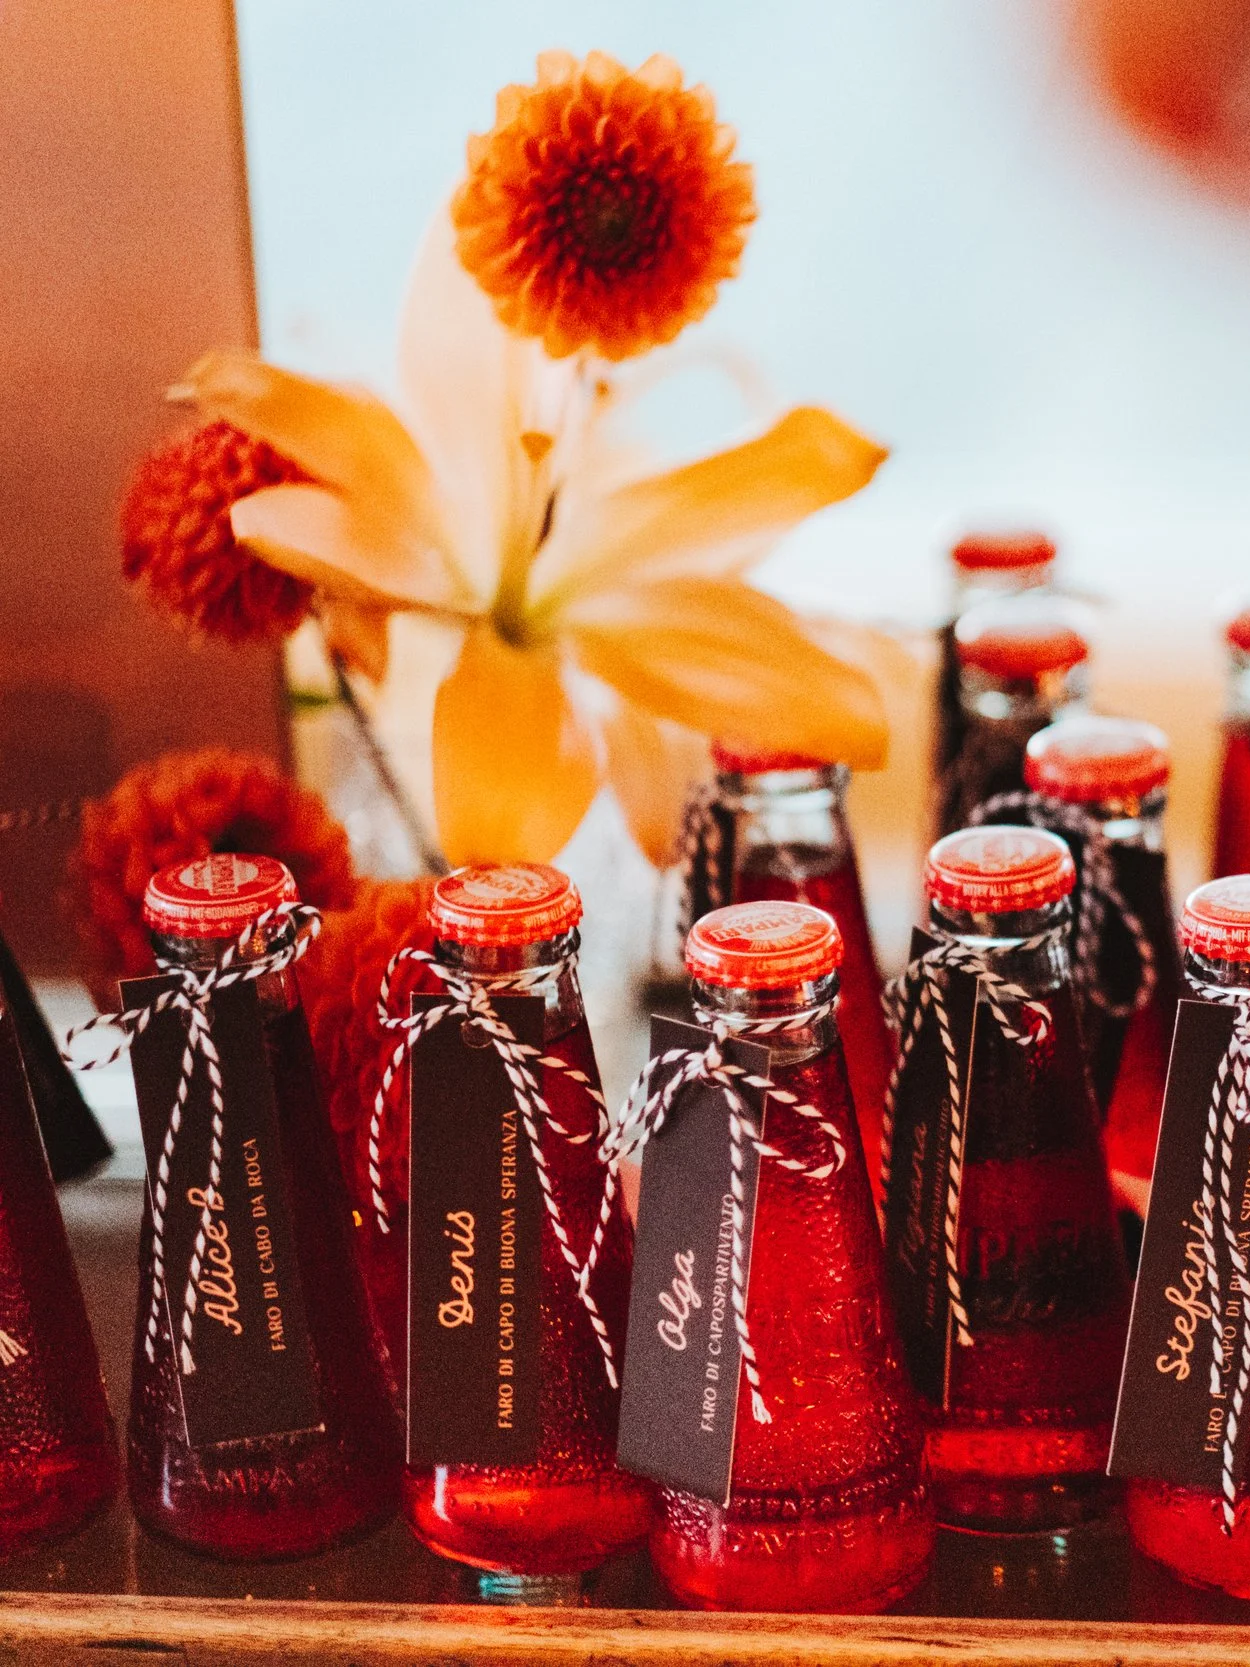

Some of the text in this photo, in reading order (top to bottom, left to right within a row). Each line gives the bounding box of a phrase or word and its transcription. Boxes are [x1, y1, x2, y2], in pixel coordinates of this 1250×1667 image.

[187, 1187, 243, 1336] Alice B
[242, 1136, 287, 1351] FARO DI CABO DA ROCA
[438, 1210, 476, 1329] Denis
[497, 1108, 518, 1429] FARO DI CAPO DI BUONA SPERANZA
[655, 1249, 703, 1352] Olga
[1154, 1193, 1216, 1381] Stefania
[1224, 1299, 1241, 1318] DI
[700, 1192, 735, 1433] FARO DI CAPOSPARTIVENTO
[1220, 1324, 1238, 1375] CAPO
[1203, 1406, 1225, 1453] FARO
